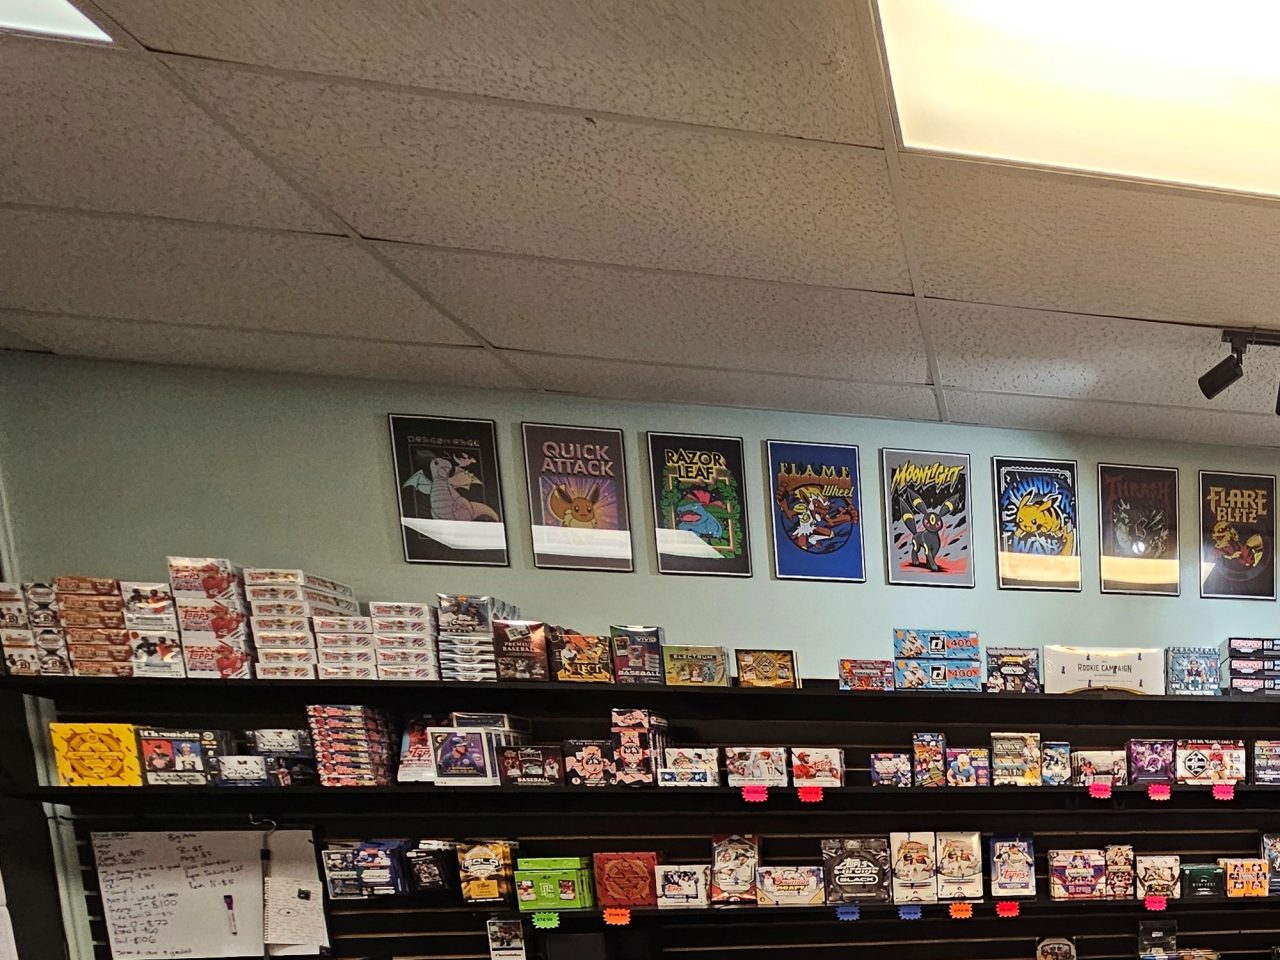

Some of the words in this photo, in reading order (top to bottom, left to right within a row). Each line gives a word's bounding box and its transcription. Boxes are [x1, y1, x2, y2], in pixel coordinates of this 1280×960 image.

[541, 441, 609, 462] QUICK
[665, 448, 725, 467] RAZOR
[541, 457, 615, 477] ATTACK
[676, 463, 716, 481] LEAF
[778, 461, 852, 479] FLAME
[891, 462, 965, 491] MOONLIGHT
[822, 483, 855, 499] Wheel
[1104, 474, 1173, 501] THRASH
[1207, 486, 1268, 516] FLARE
[1216, 507, 1258, 524] BLITZ
[950, 638, 974, 648] 400
[1231, 639, 1263, 650] MONOPOLY
[563, 660, 602, 675] SELECT
[1077, 662, 1101, 673] ROOKIE
[1232, 659, 1264, 670] MONOPOLY
[1232, 678, 1264, 689] MONOPOLY
[143, 730, 201, 738] Chronicles
[463, 859, 500, 868] GOLD
